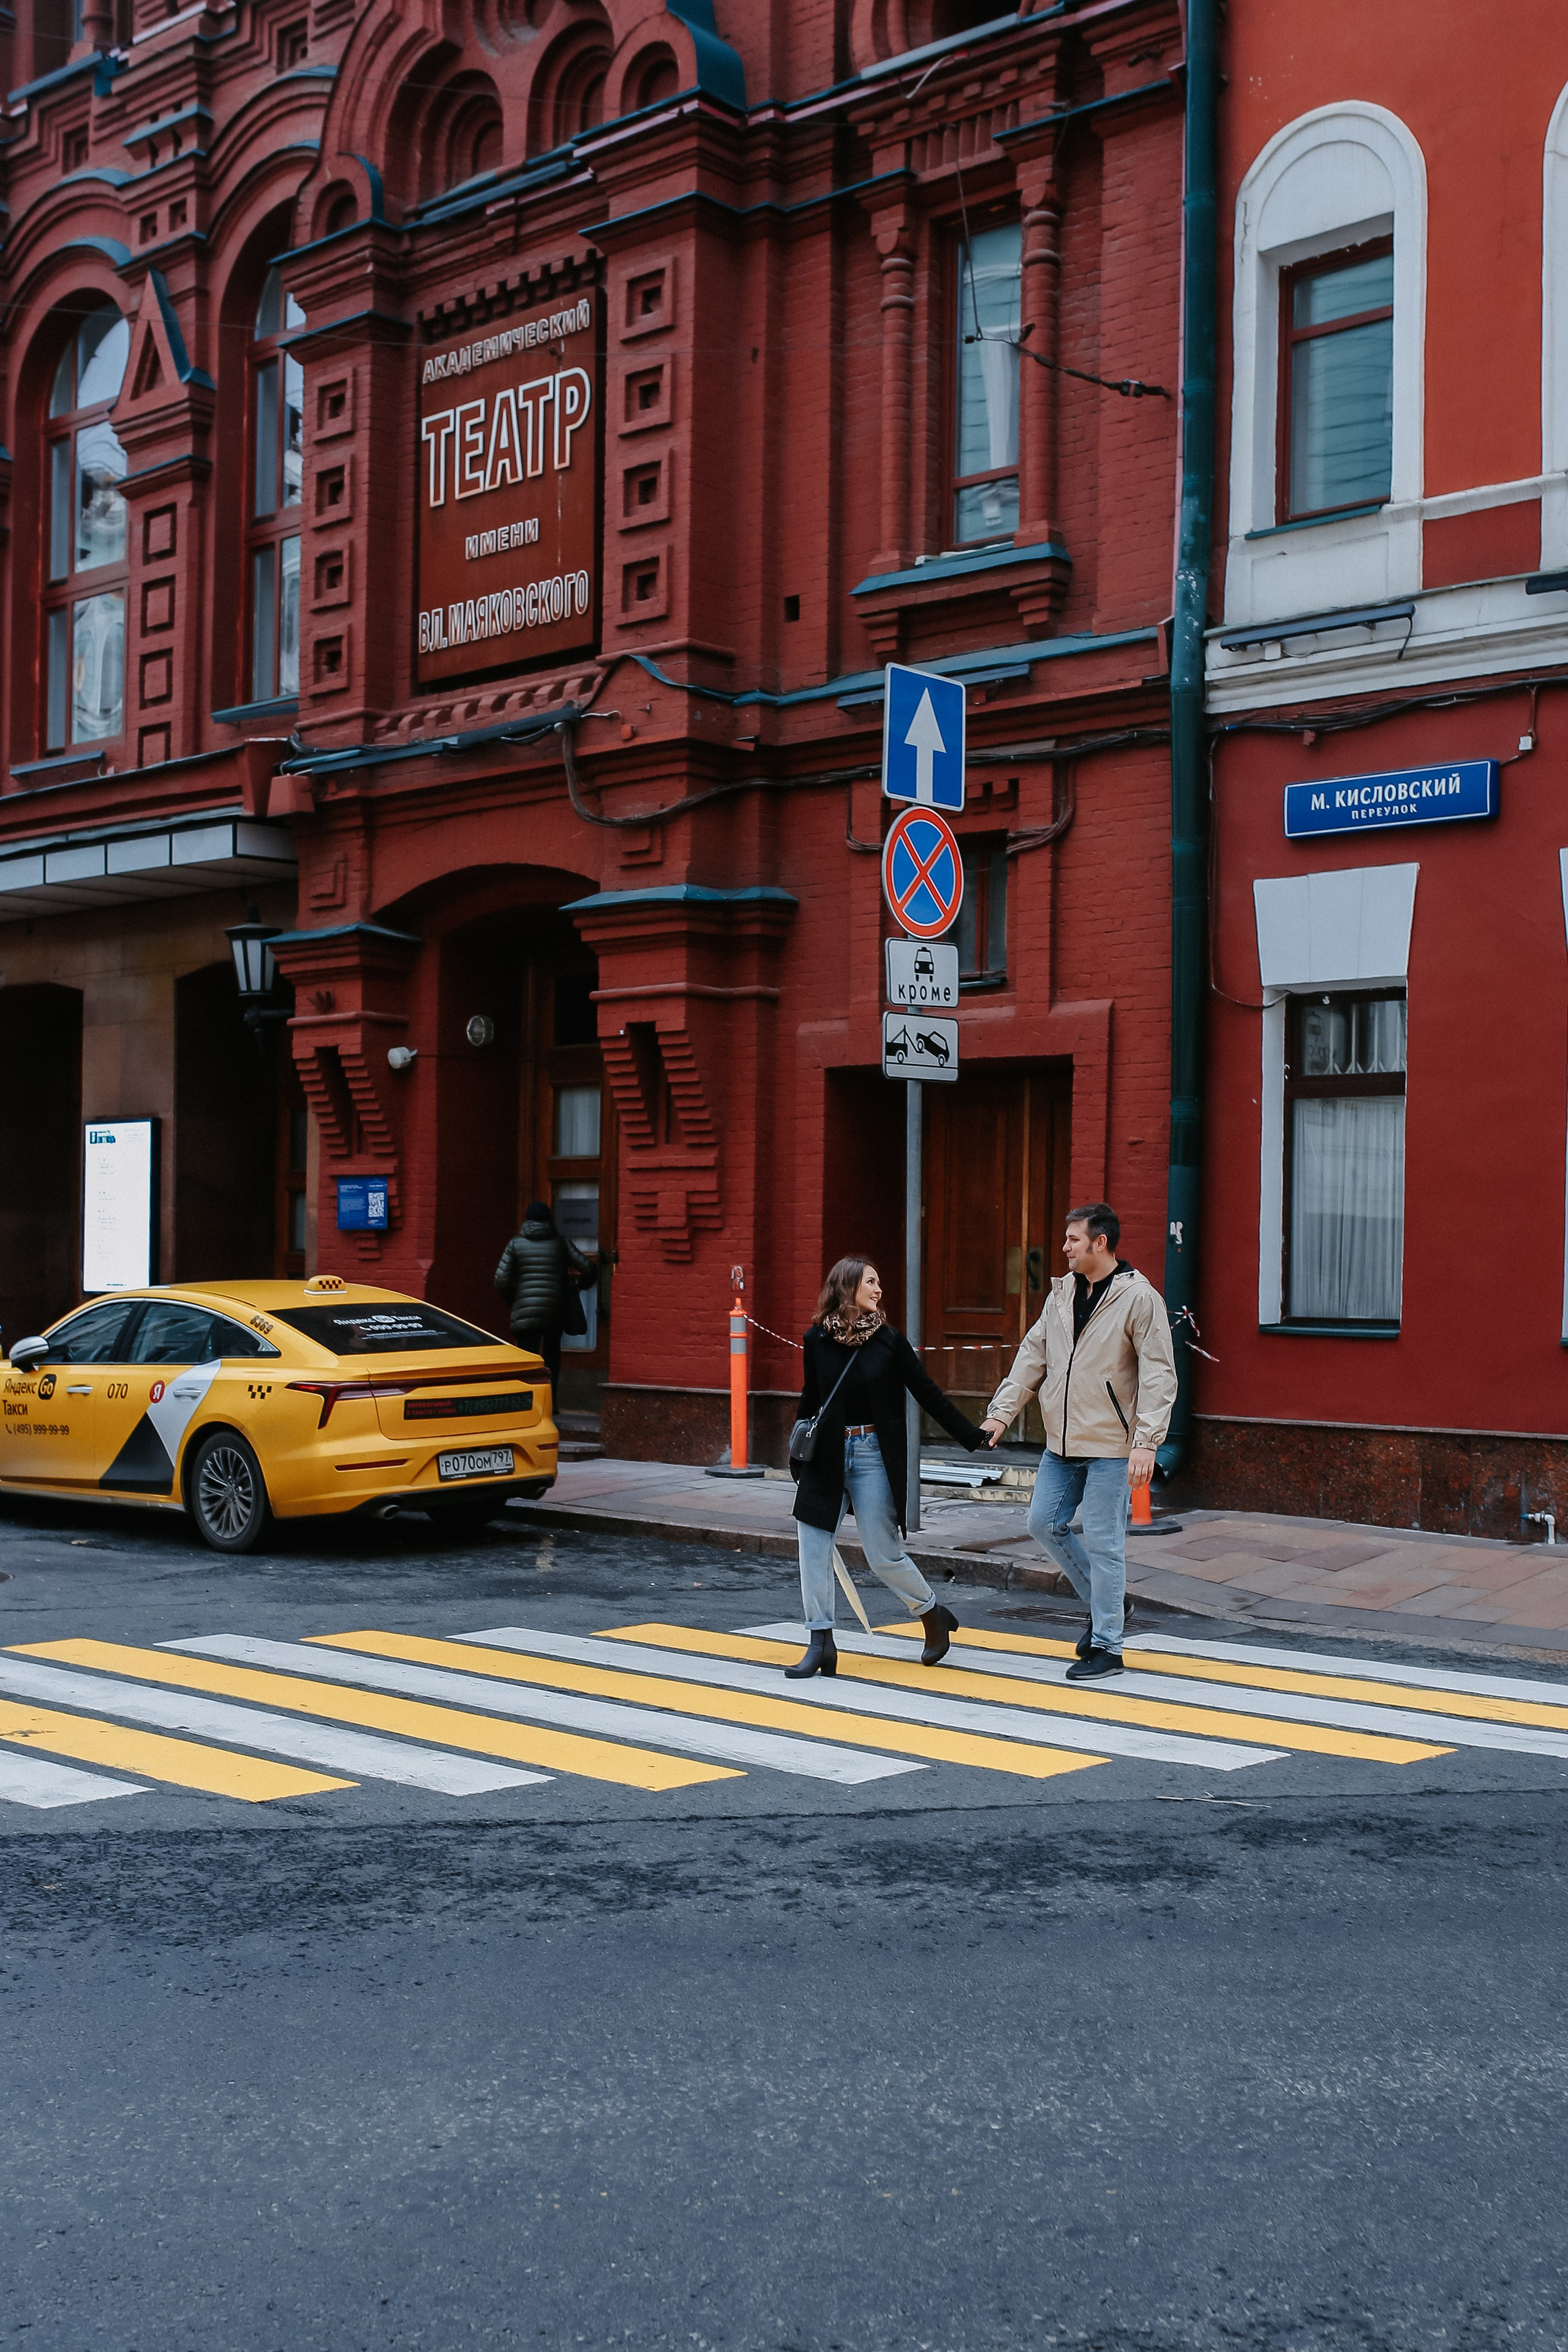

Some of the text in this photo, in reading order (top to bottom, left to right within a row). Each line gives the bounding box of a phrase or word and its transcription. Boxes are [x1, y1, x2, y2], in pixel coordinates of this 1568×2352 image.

[423, 298, 590, 384] АКАДЕМИЧЕСКИЙ
[421, 367, 590, 507] ТЕАТР
[466, 518, 539, 560] ИМЕНИ
[1311, 772, 1461, 811] М. КИСЛОВСКИЙ
[1351, 803, 1418, 820] ПЕРЕУЛОК
[250, 1315, 274, 1335] 8369
[4, 1378, 54, 1396] Яндекс Go
[107, 1383, 128, 1399] 070
[153, 1384, 162, 1400] Я
[2, 1400, 28, 1415] Такси
[13, 1423, 70, 1435] (495) 999-99-99
[492, 1450, 509, 1463] 797
